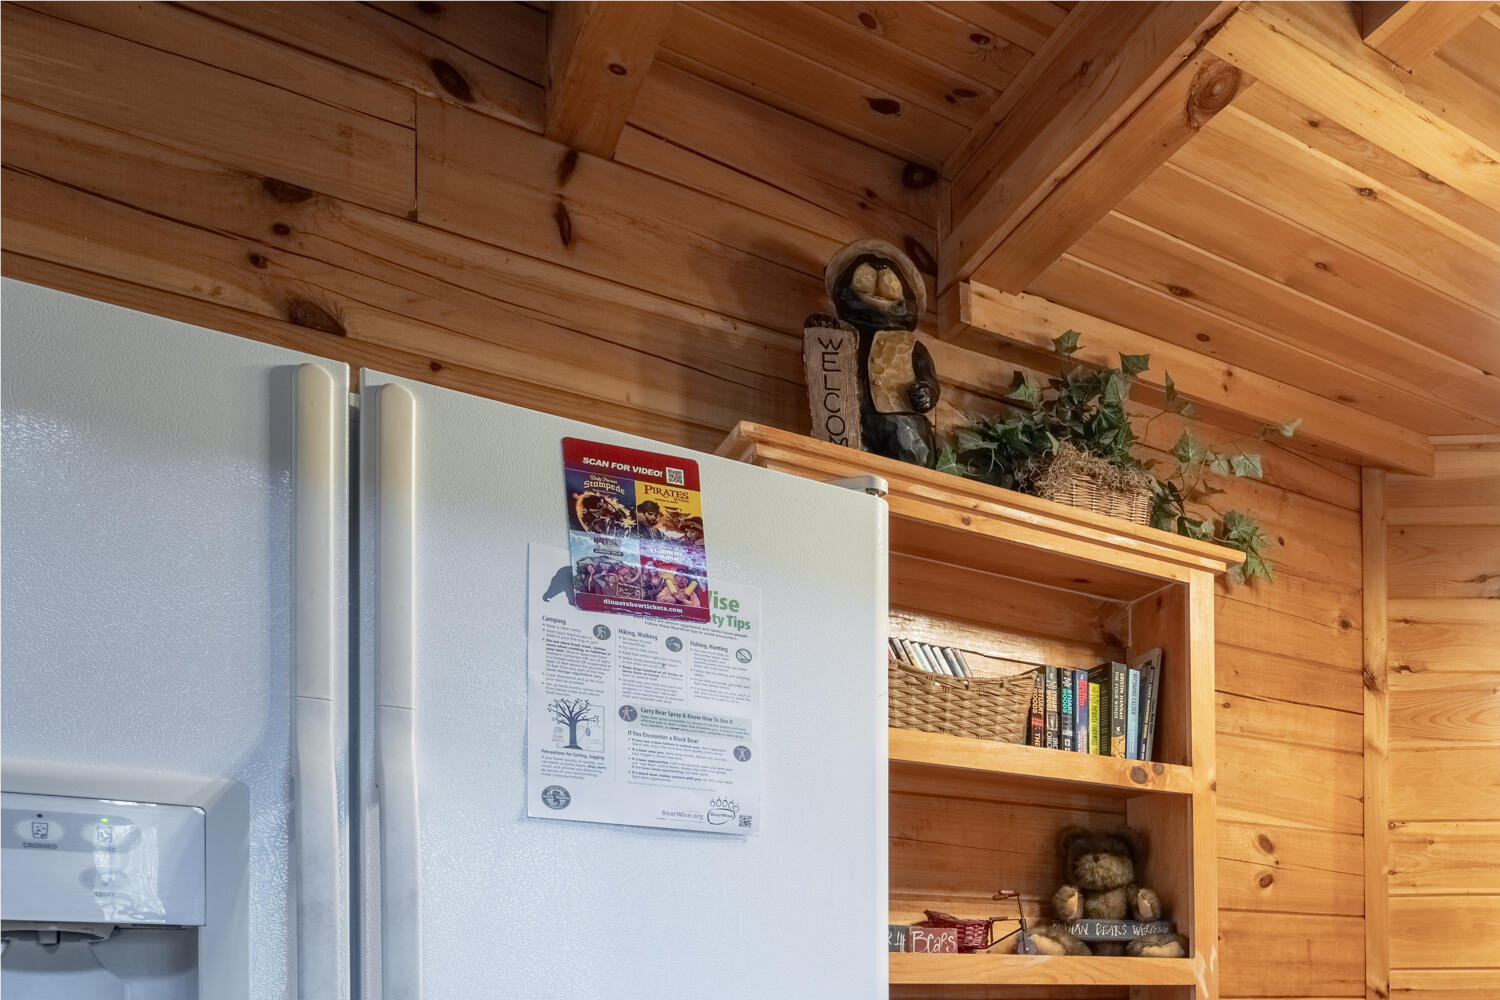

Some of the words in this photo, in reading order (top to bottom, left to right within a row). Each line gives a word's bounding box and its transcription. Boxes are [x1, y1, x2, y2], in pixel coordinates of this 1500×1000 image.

[582, 456, 610, 468] SCAN
[611, 462, 630, 472] FOR
[632, 465, 663, 477] VIDEO!
[583, 480, 625, 495] Stampede
[644, 484, 689, 500] PIRATES
[603, 598, 683, 613] dinnershowtickets.com
[541, 615, 567, 625] Camping
[726, 615, 751, 632] Tips
[618, 628, 637, 638] Hiking,
[637, 631, 658, 641] Walking
[640, 708, 654, 716] Carry
[667, 711, 682, 719] Spray
[642, 732, 668, 740] Encounter
[672, 735, 687, 743] Black
[661, 809, 704, 820] BearWise.org
[22, 842, 58, 850] CRUSHED
